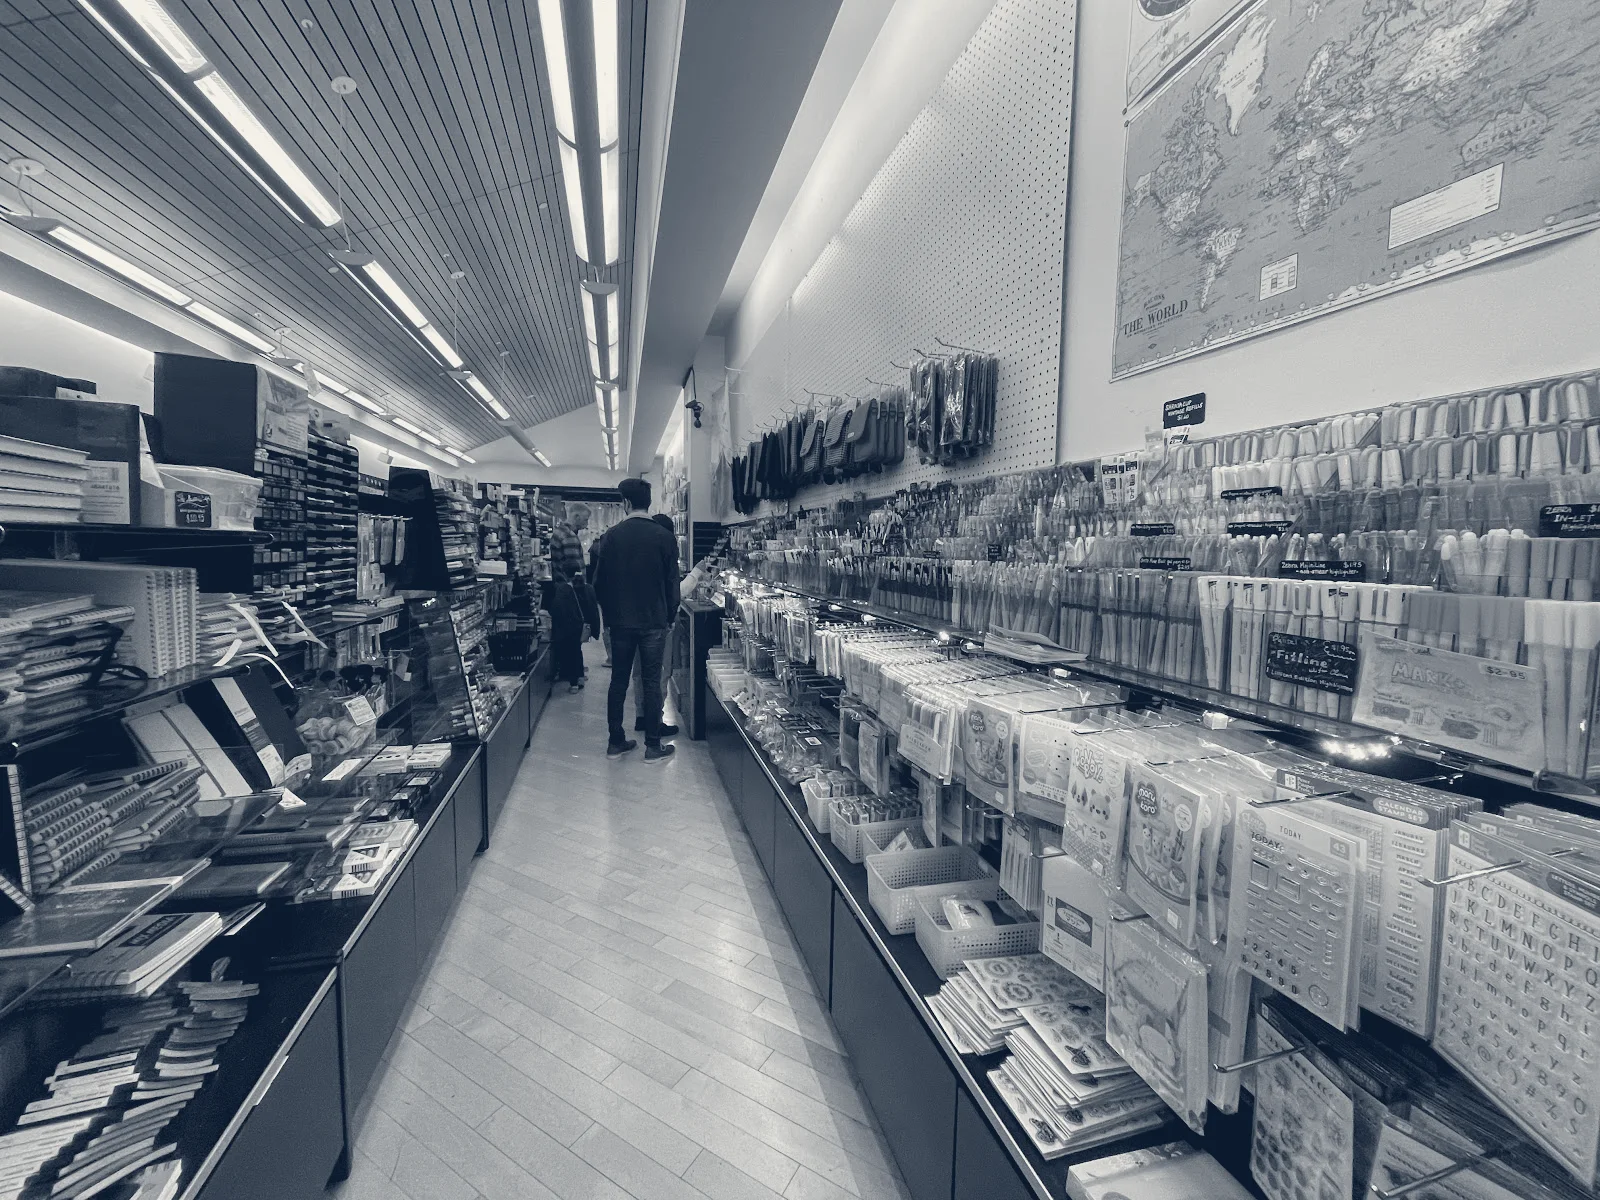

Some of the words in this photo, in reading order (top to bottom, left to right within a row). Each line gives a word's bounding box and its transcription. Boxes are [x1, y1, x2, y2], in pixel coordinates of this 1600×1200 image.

[1123, 317, 1143, 335] THE
[1148, 299, 1188, 325] WORLD
[1554, 514, 1595, 523] IN-LET
[1378, 800, 1423, 816] CALENDAR
[1378, 806, 1405, 817] STAMP
[1407, 813, 1424, 822] SET
[1280, 825, 1302, 840] TODAY
[1394, 829, 1423, 841] JANUARY
[1333, 842, 1346, 854] 43
[1391, 840, 1425, 854] FEBRUARY
[1396, 854, 1419, 864] MARCH
[1397, 867, 1416, 876] APRIL
[1397, 891, 1413, 900] JUNE
[1467, 878, 1475, 892] B
[1481, 885, 1490, 902] C
[1497, 894, 1506, 909] D
[1513, 902, 1522, 920] E
[1531, 911, 1540, 928] F
[1548, 923, 1559, 940] G
[1568, 932, 1580, 953] H
[1451, 890, 1458, 904] J
[1467, 898, 1477, 916] K
[1484, 908, 1493, 926] L
[1501, 918, 1513, 938] M
[1522, 930, 1534, 950] N
[1542, 943, 1553, 961] O
[1564, 955, 1574, 972] P
[1585, 967, 1598, 988] Q
[1243, 937, 1247, 946] 1
[1252, 942, 1258, 953] 2
[1264, 949, 1271, 960] 3
[1277, 958, 1284, 968] 4
[1290, 965, 1297, 975] 5
[1449, 908, 1457, 926] R
[1463, 918, 1469, 933] S
[1476, 925, 1485, 941] T
[1490, 935, 1500, 951] U
[1506, 944, 1516, 961] V
[1523, 954, 1537, 974] W
[1544, 968, 1555, 987] X
[1564, 979, 1575, 998] Y
[1585, 993, 1596, 1013] Z
[1241, 953, 1248, 964] 6
[1253, 960, 1259, 970] 7
[1265, 968, 1272, 979] 8
[1278, 976, 1284, 986] 9
[1291, 984, 1297, 995] 0
[1447, 933, 1454, 944] a
[1461, 937, 1469, 953] b
[1475, 951, 1481, 962] c
[1488, 959, 1497, 973] d
[1505, 972, 1514, 984] e
[1538, 995, 1550, 1012] g
[1560, 1003, 1570, 1023] h
[1583, 1022, 1590, 1036] i
[1460, 958, 1467, 974] k
[1486, 981, 1498, 997] m
[1505, 995, 1514, 1008] n
[1521, 1007, 1529, 1018] o
[1537, 1018, 1547, 1034] p
[1557, 1033, 1568, 1052] q
[1579, 1047, 1589, 1059] r
[1452, 1003, 1460, 1017] 2
[1464, 1011, 1473, 1027] 3
[1477, 1023, 1486, 1037] 4
[1492, 1033, 1501, 1048] 5
[1506, 1045, 1515, 1061] 6
[1522, 1056, 1531, 1071] 7
[1537, 1068, 1548, 1087] 8
[1555, 1082, 1567, 1098] 9
[1573, 1097, 1587, 1116] 0
[1507, 1023, 1518, 1037] w
[1528, 1041, 1538, 1053] x
[1549, 1054, 1560, 1071] y
[1572, 1072, 1582, 1086] z
